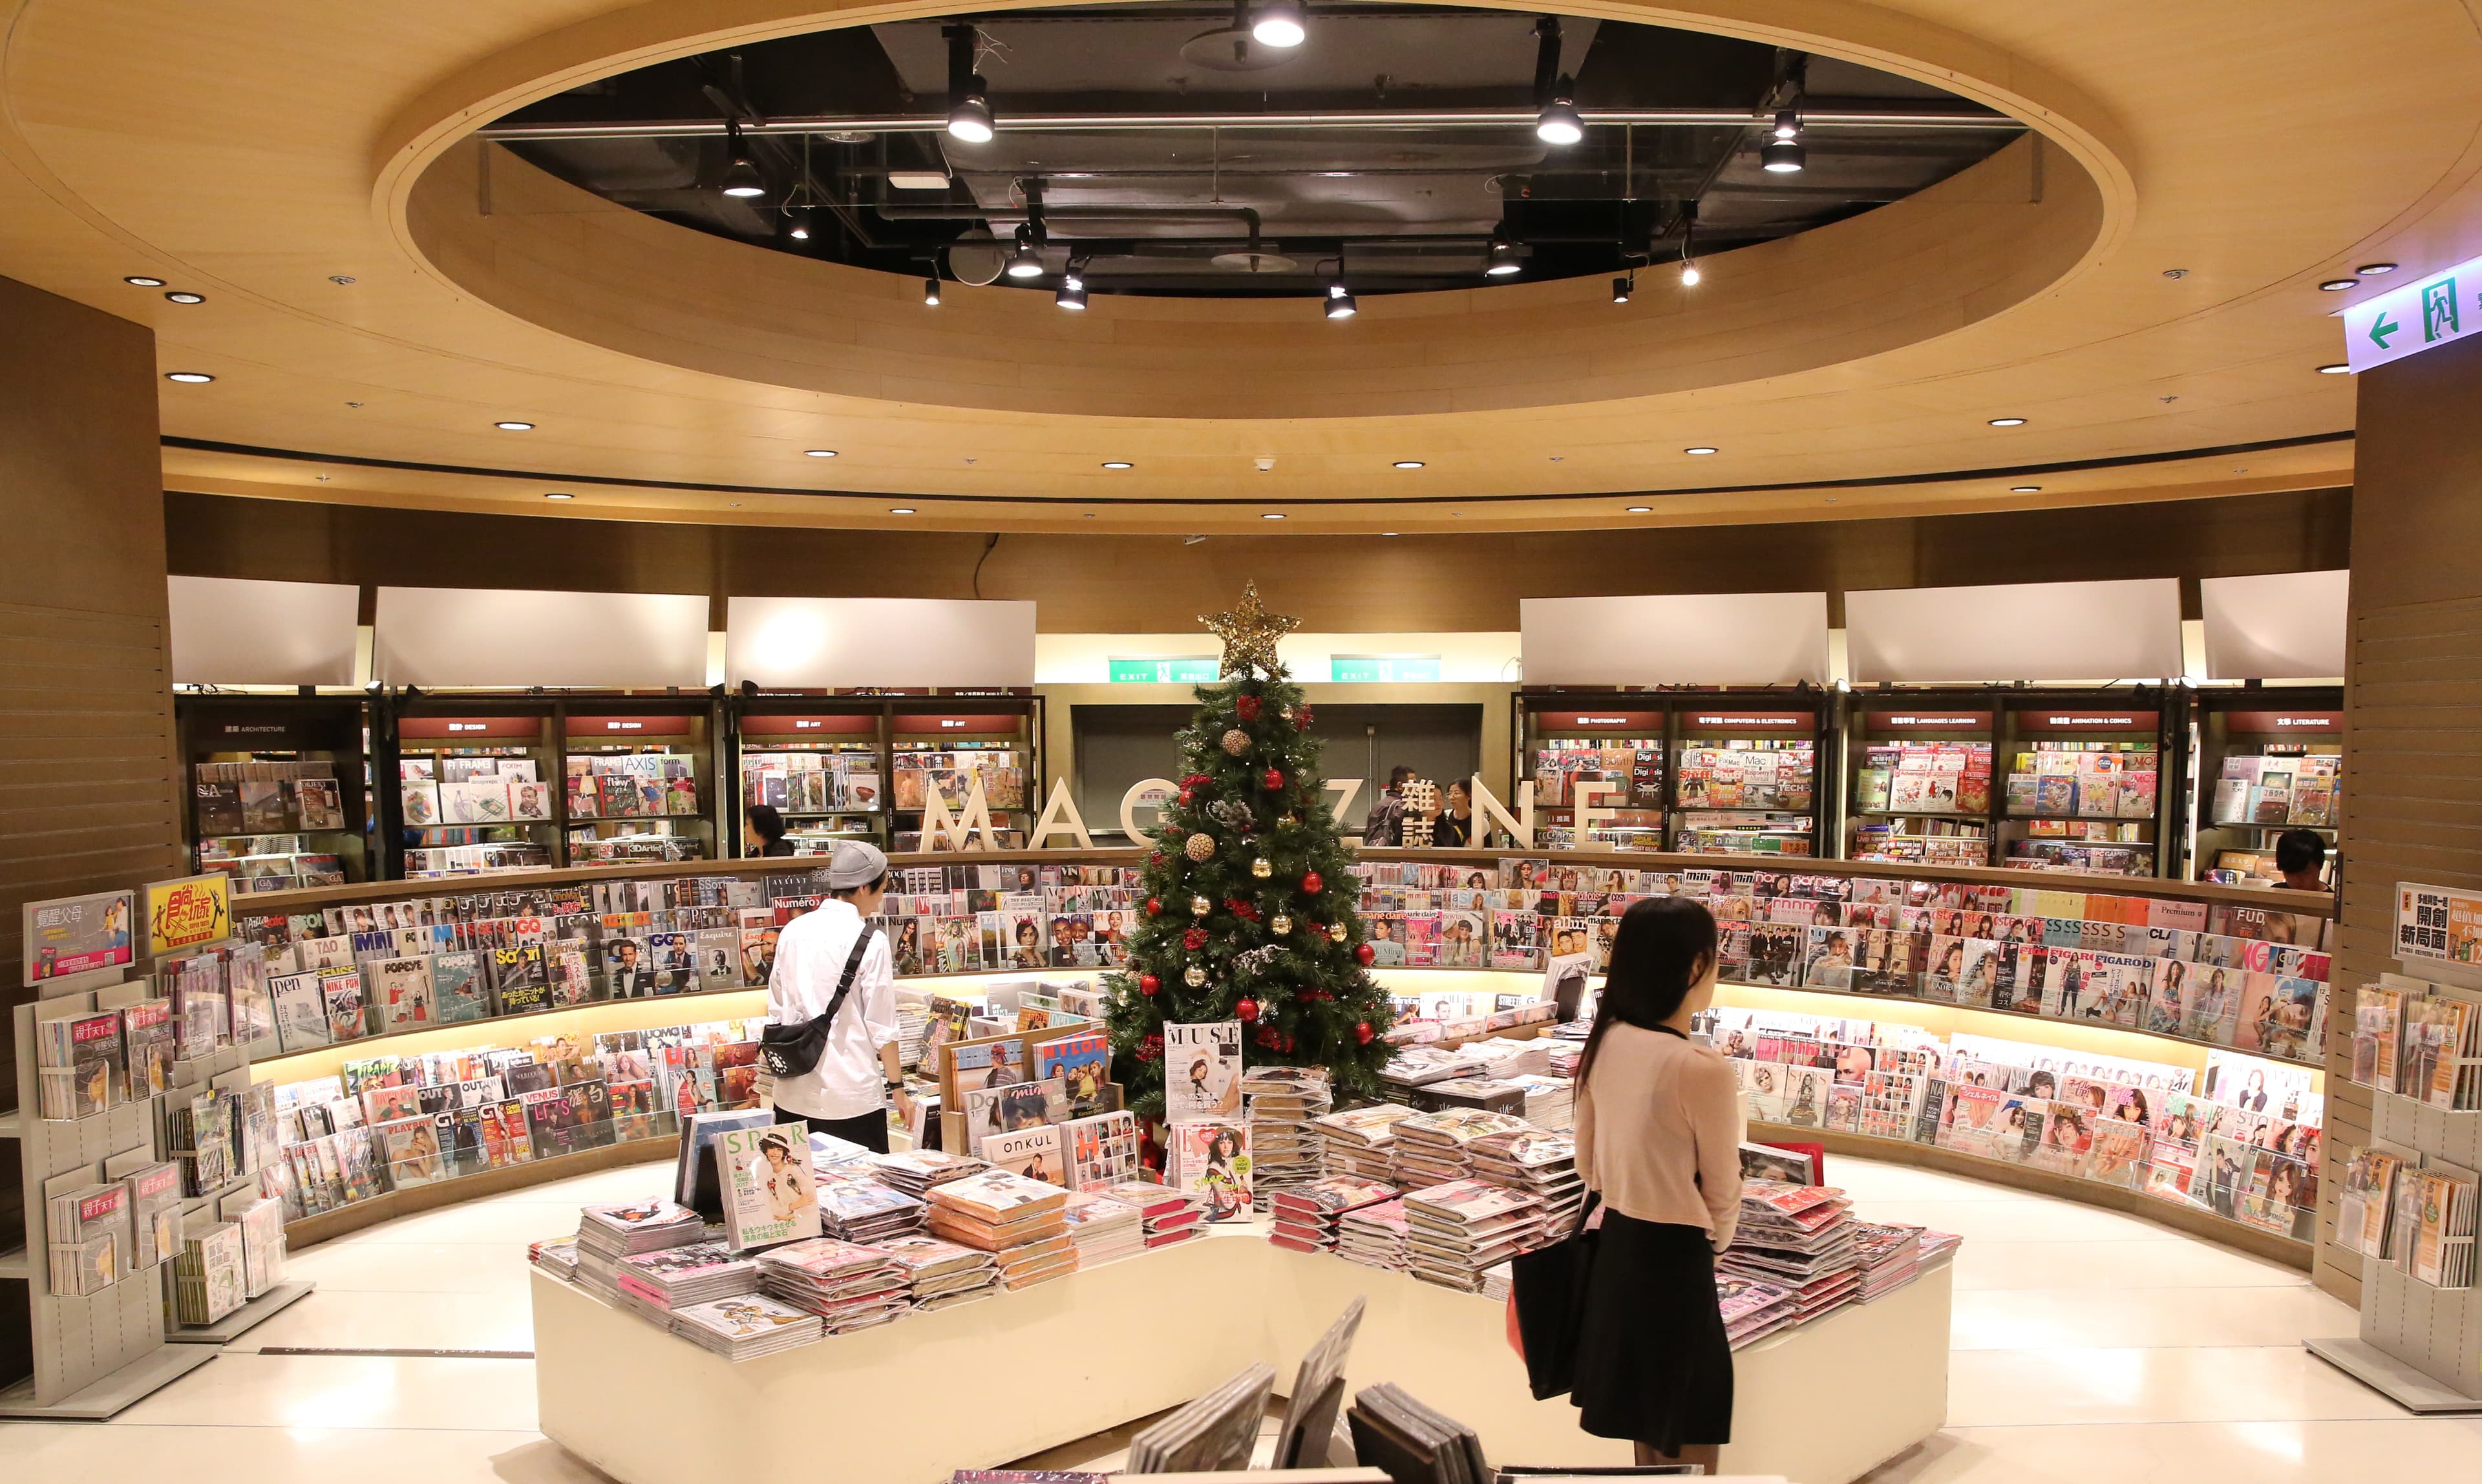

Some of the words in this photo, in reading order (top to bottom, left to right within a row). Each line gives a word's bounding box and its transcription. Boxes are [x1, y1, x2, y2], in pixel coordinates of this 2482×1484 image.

[625, 757, 656, 770] AXIS
[1745, 755, 1766, 766] Mac
[1001, 866, 1015, 875] Frog
[1686, 871, 1711, 881] mini
[774, 897, 816, 909] Numéro
[36, 905, 83, 928] 覺醒父母
[2161, 906, 2195, 917] Premium
[2416, 905, 2448, 929] 開創
[516, 918, 542, 935] GQ
[699, 931, 734, 940] Esquire
[2401, 924, 2446, 951] 新局面
[385, 960, 424, 974] POPEYE
[2094, 955, 2142, 968] FIGARO
[273, 977, 301, 998] pen
[326, 980, 343, 993] NIKE
[346, 977, 359, 990] FUN
[1168, 1026, 1240, 1045] MUSE
[1043, 1037, 1107, 1060] NYLON
[462, 1081, 482, 1092] OUT
[419, 1088, 442, 1101] OUT
[525, 1089, 558, 1103] VENUS
[726, 1123, 808, 1154] SPR
